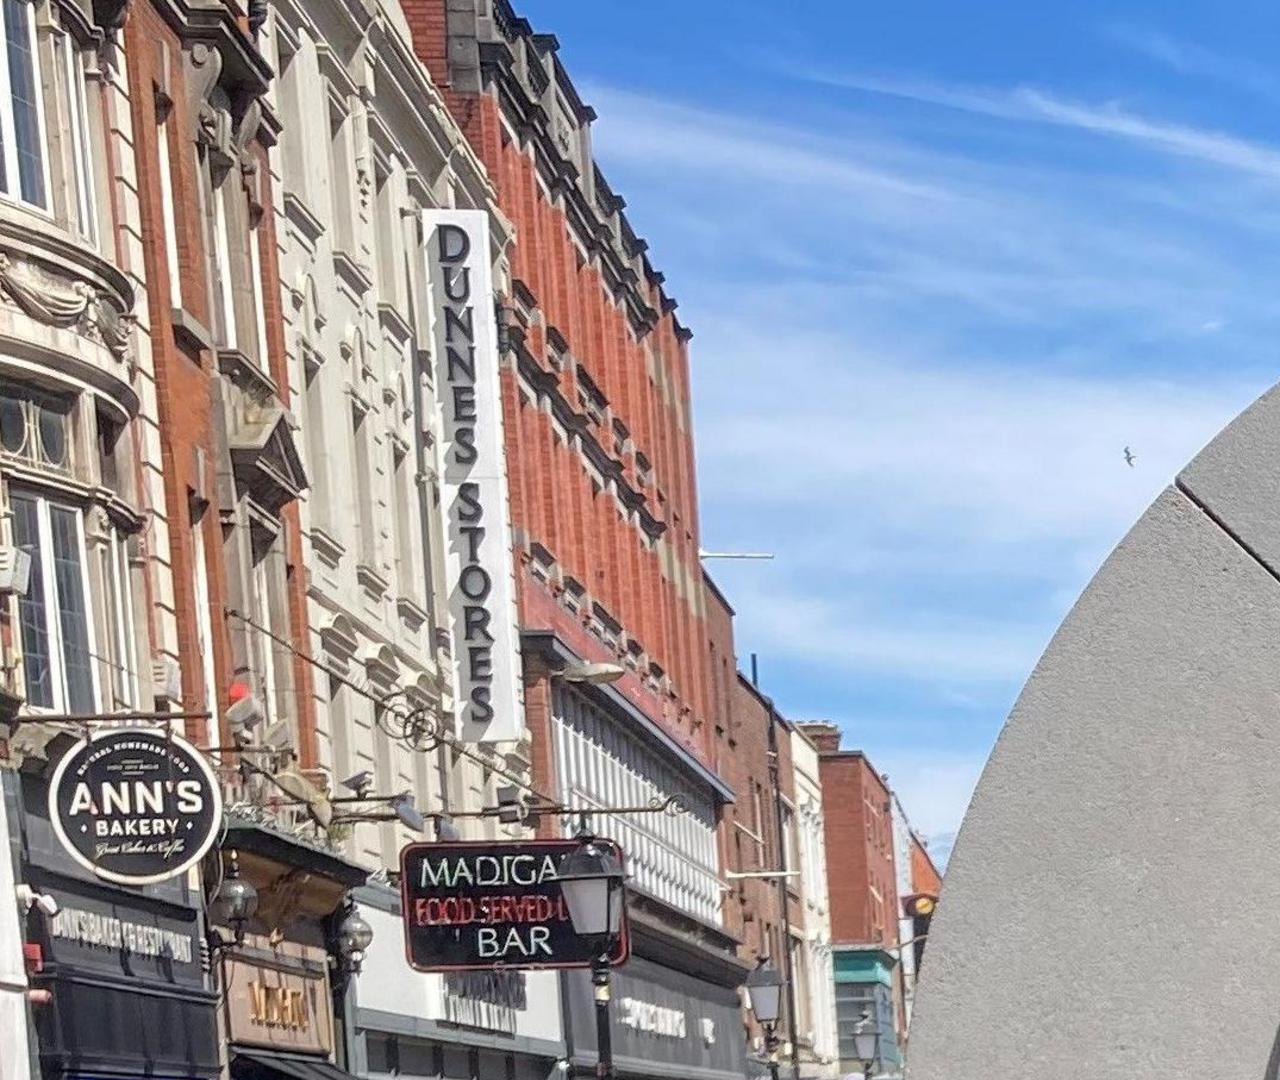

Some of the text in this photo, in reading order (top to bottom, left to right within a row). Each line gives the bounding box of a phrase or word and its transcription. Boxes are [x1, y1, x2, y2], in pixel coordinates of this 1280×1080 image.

[436, 222, 495, 724] DUNNES STORES
[69, 780, 203, 815] ANN'S
[95, 818, 179, 837] BAKERY
[420, 854, 568, 888] MADIGA
[415, 897, 475, 926] FOOD
[479, 895, 551, 923] SERVED
[478, 926, 553, 958] BAR
